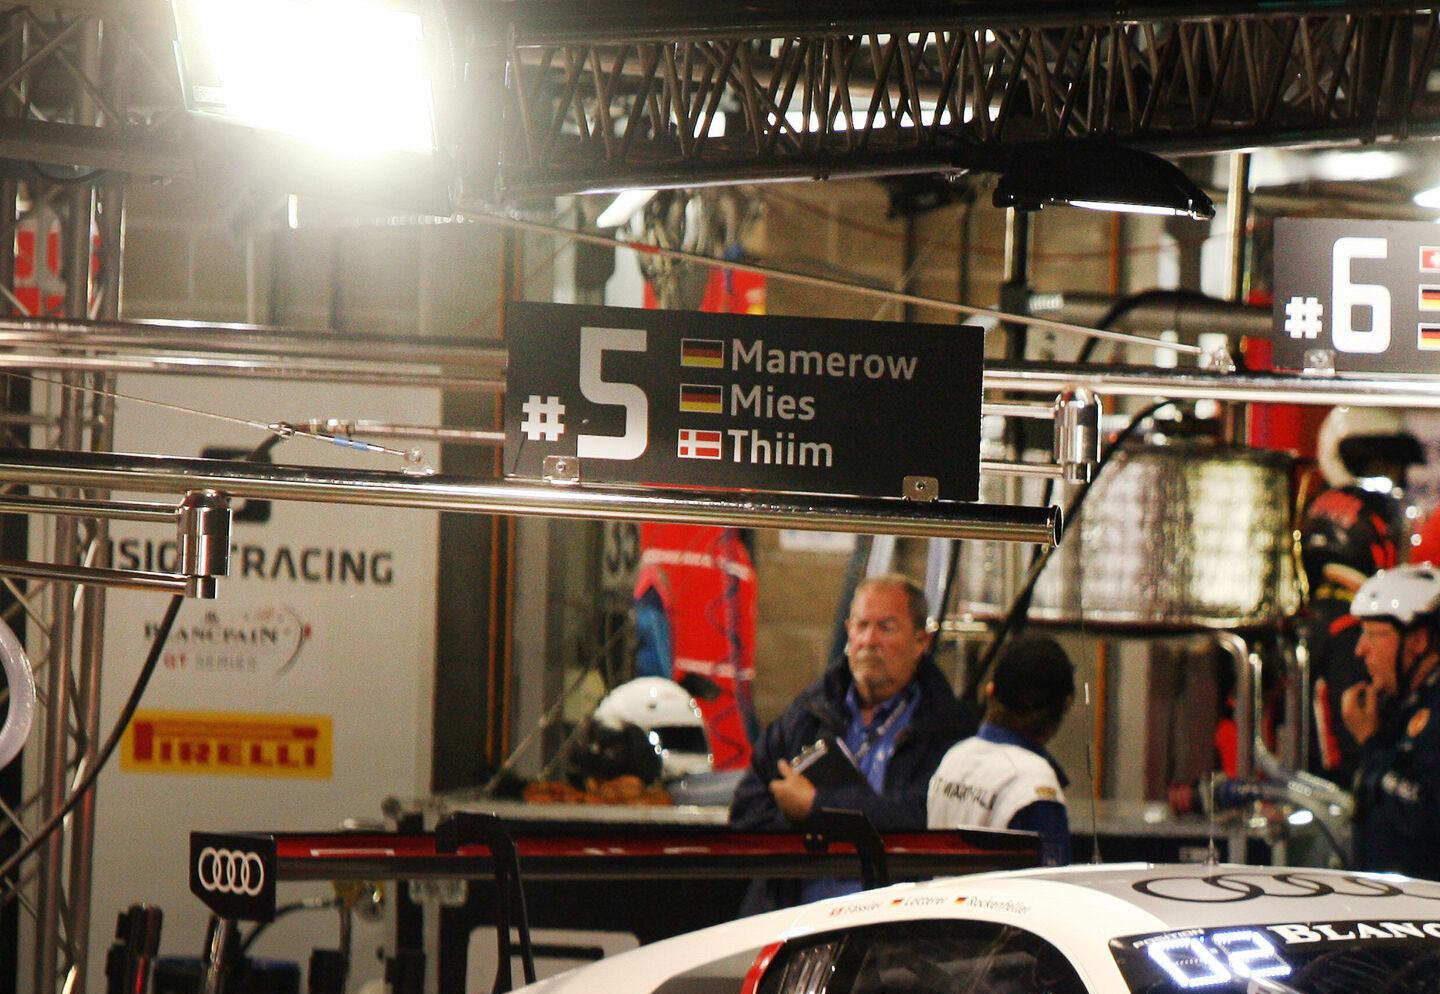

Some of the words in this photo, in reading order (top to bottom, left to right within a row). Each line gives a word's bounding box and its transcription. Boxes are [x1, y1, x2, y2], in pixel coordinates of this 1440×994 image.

[731, 339, 918, 380] Mamerow
[731, 384, 816, 421] Mies
[728, 429, 833, 467] Thiim
[132, 721, 319, 767] PIRELLI
[1148, 930, 1292, 988] 02
